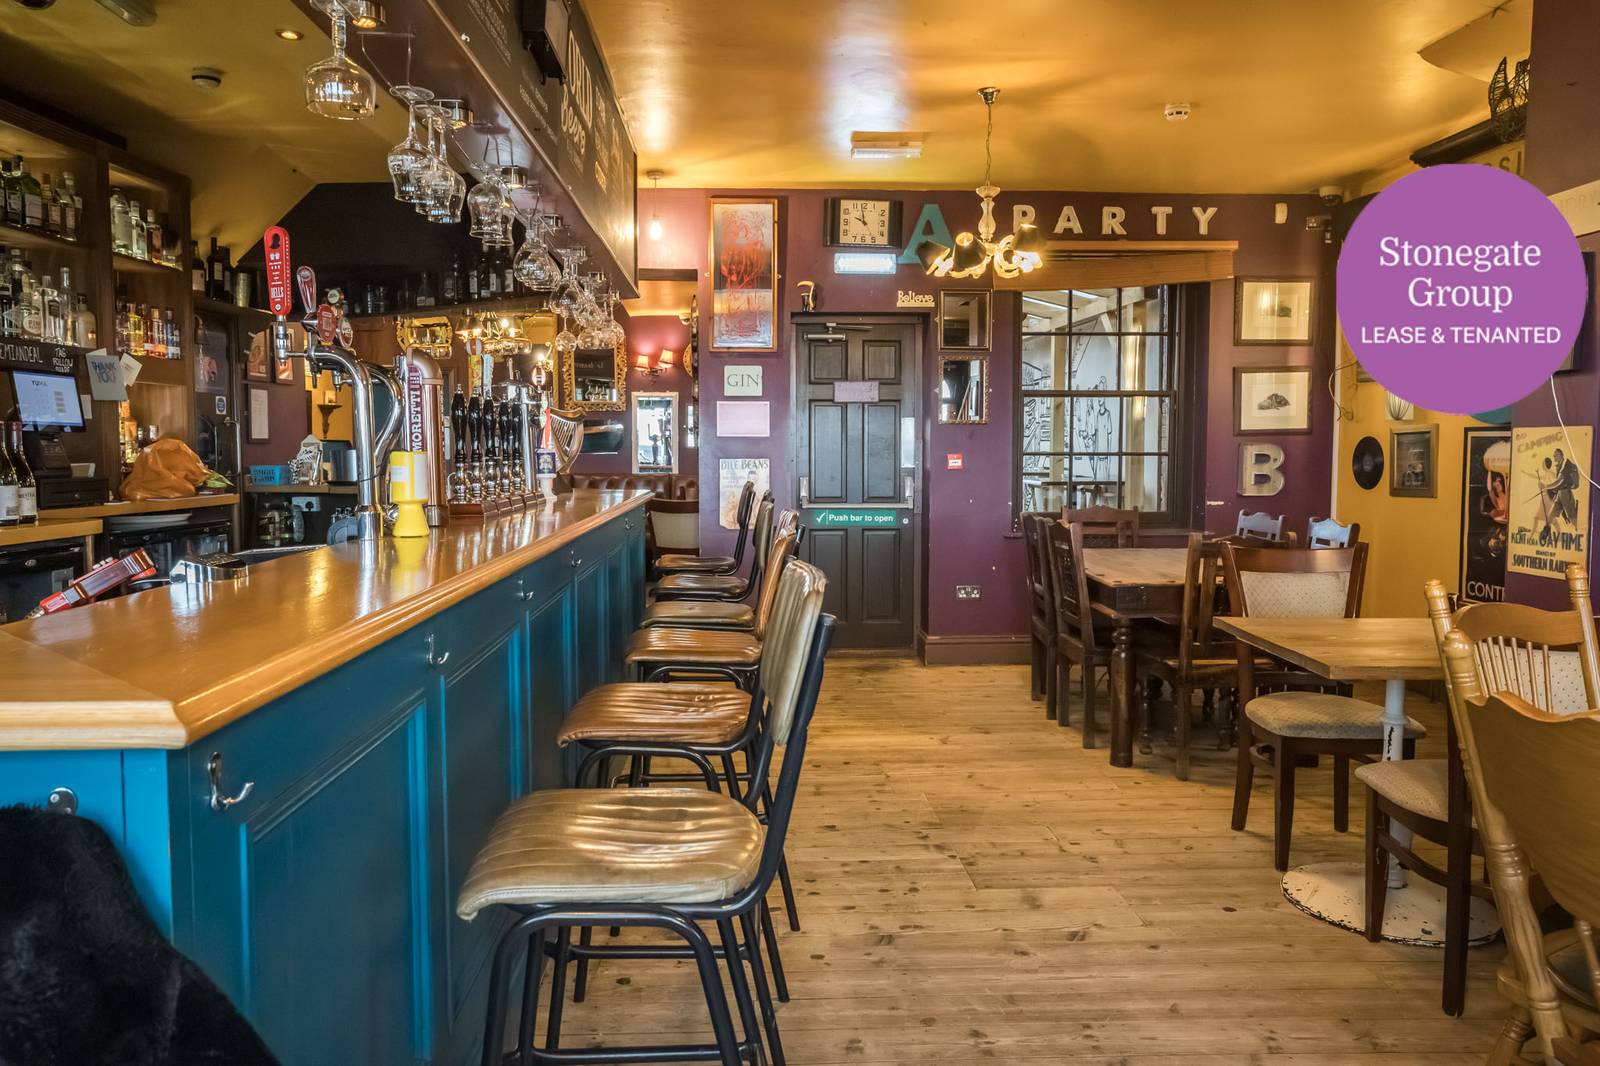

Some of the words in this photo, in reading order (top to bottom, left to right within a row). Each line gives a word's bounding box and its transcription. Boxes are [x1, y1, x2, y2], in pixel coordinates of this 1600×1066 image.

[568, 29, 592, 130] ORLD
[896, 203, 953, 264] A
[1012, 204, 1218, 236] PARTY
[898, 290, 934, 303] Believe
[727, 374, 760, 388] GIN
[411, 391, 423, 452] MORETTI
[1517, 431, 1563, 453] CAMPING
[741, 459, 769, 471] BEANS
[1239, 443, 1286, 497] B
[828, 513, 848, 522] Push
[850, 513, 863, 522] bar
[864, 514, 873, 522] to
[874, 515, 894, 523] open
[1561, 532, 1584, 553] TIME
[1512, 554, 1549, 571] SOUTHERN
